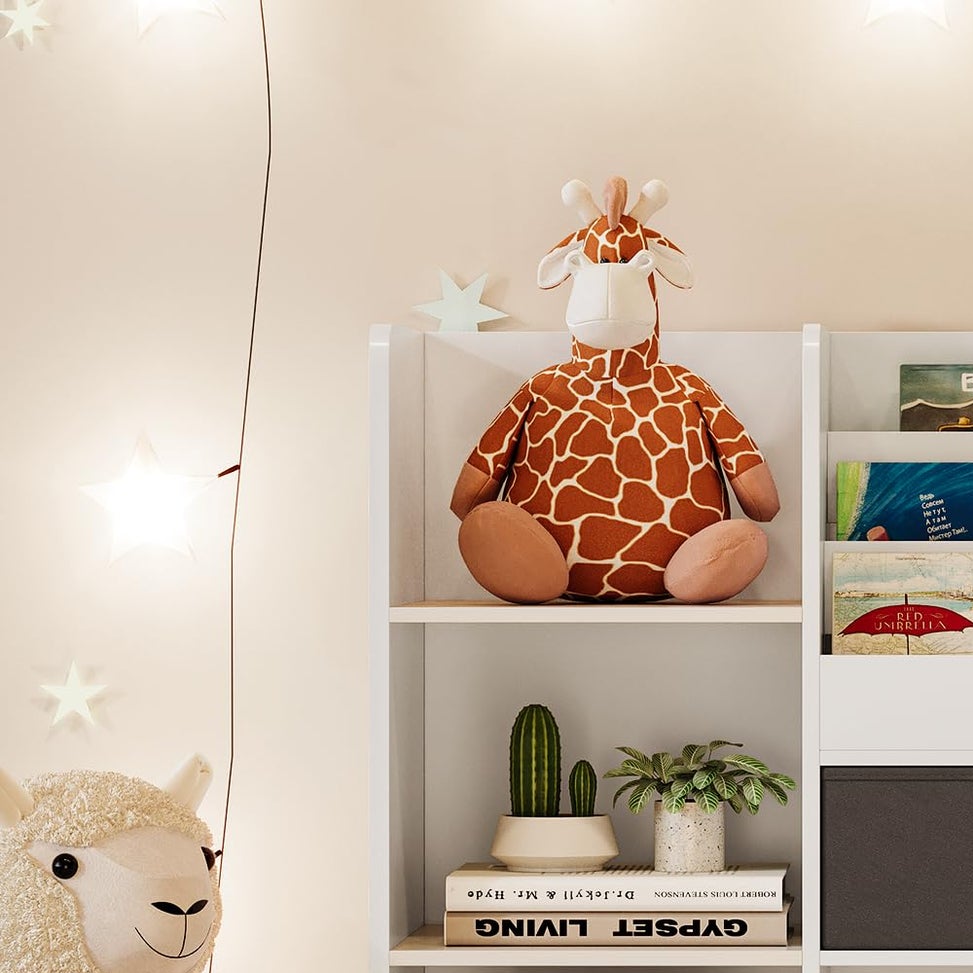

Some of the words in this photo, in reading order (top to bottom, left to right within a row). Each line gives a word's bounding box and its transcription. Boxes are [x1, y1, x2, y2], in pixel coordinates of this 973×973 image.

[897, 612, 923, 621] RED
[873, 620, 947, 631] UMBRELLA
[467, 889, 505, 901] Hyde
[513, 889, 538, 900] Mr.
[546, 889, 557, 900] &
[654, 889, 709, 898] STEVENSON
[710, 889, 739, 898] LOUIS
[740, 889, 778, 898] ROBERT
[475, 918, 588, 938] LIVING
[612, 918, 750, 938] GYPSET
